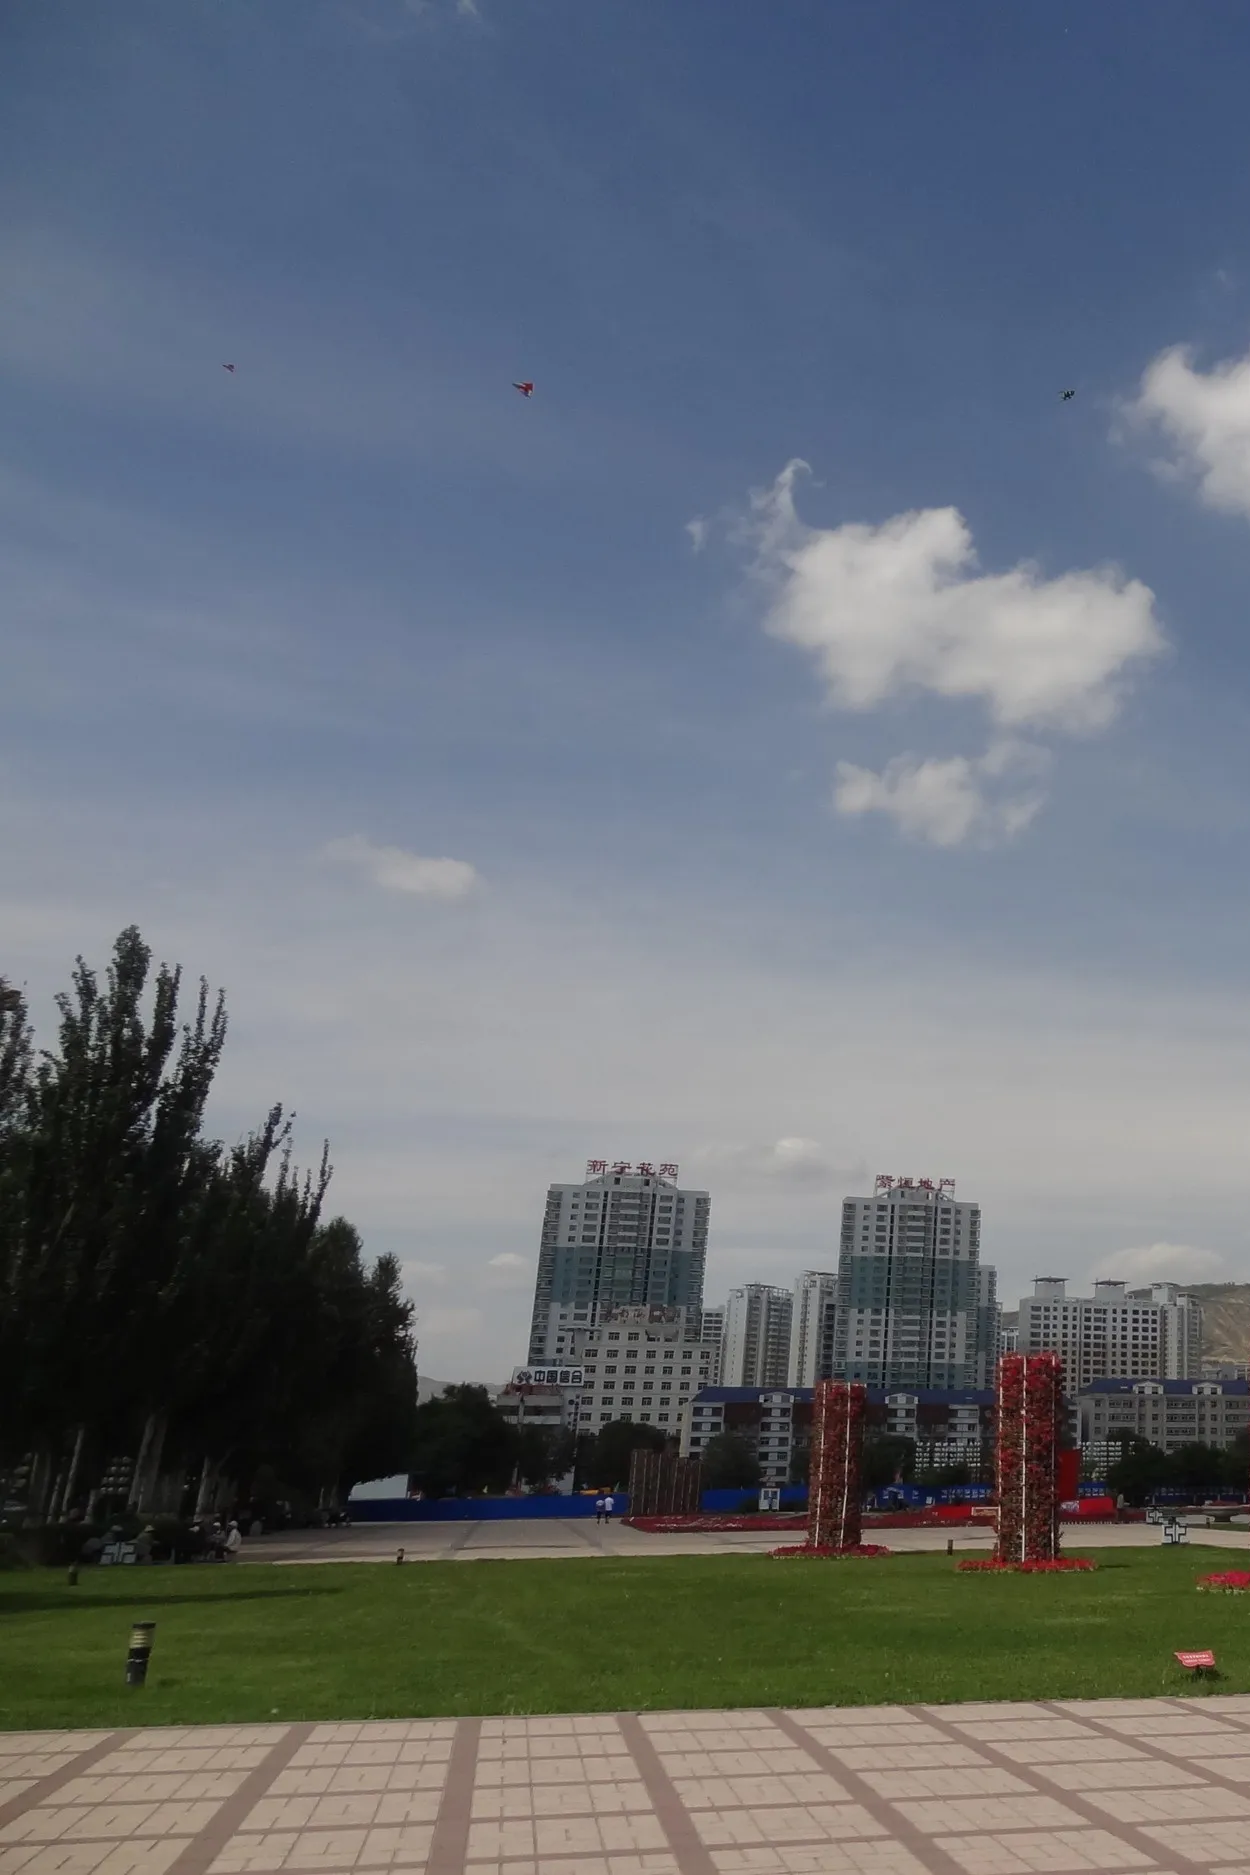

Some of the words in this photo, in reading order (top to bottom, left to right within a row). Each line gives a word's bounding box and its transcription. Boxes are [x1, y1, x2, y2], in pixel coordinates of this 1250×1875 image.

[586, 1159, 679, 1176] 新宁花苑
[534, 1370, 582, 1383] 中国信合
